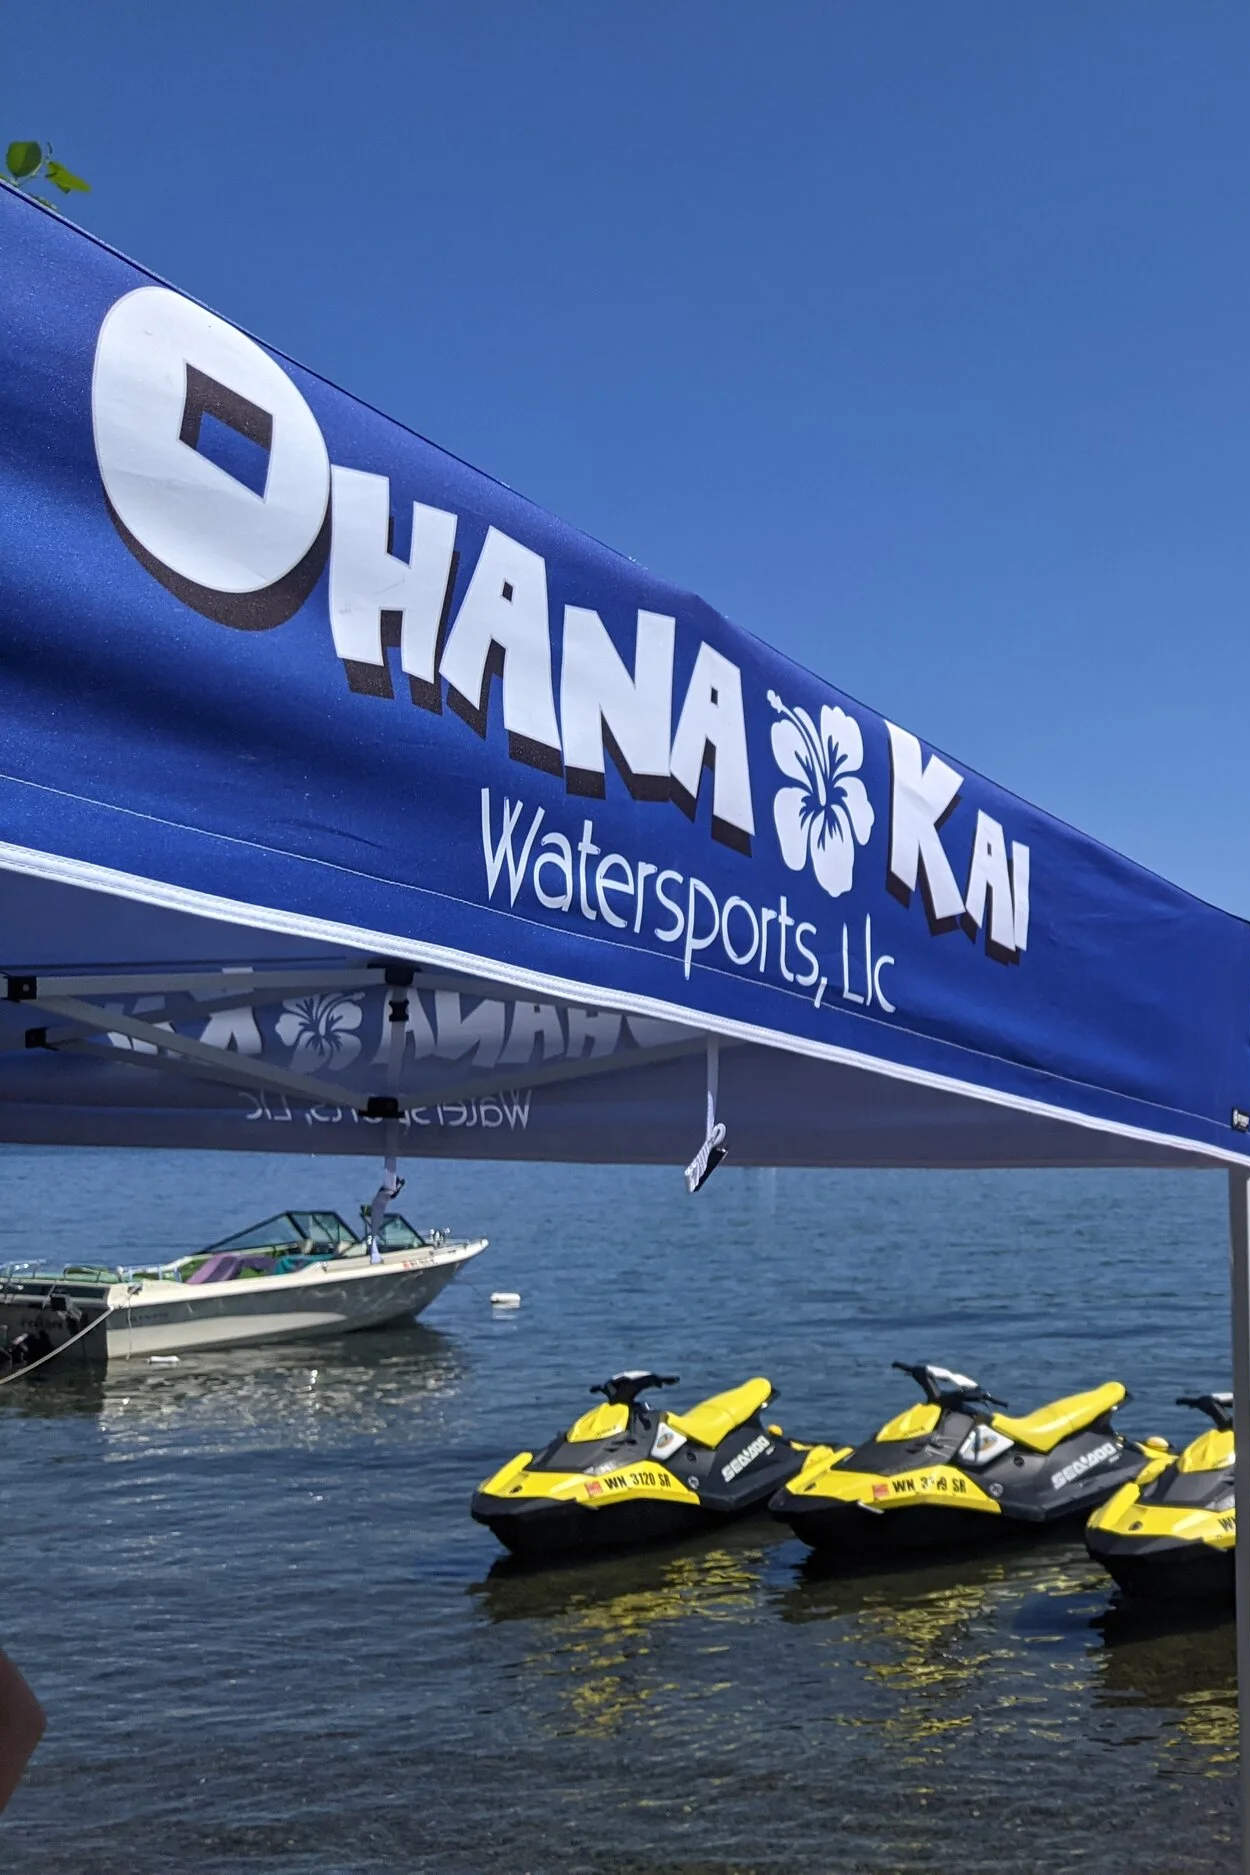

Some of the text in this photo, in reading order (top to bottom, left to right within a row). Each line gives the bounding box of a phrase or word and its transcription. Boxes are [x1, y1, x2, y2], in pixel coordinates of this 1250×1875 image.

[92, 286, 1031, 964] OHANA KAI
[481, 788, 828, 1008] Watersports,
[604, 1475, 627, 1489] WN
[658, 1473, 671, 1487] SR
[892, 1479, 915, 1493] WN
[952, 1478, 966, 1493] SR
